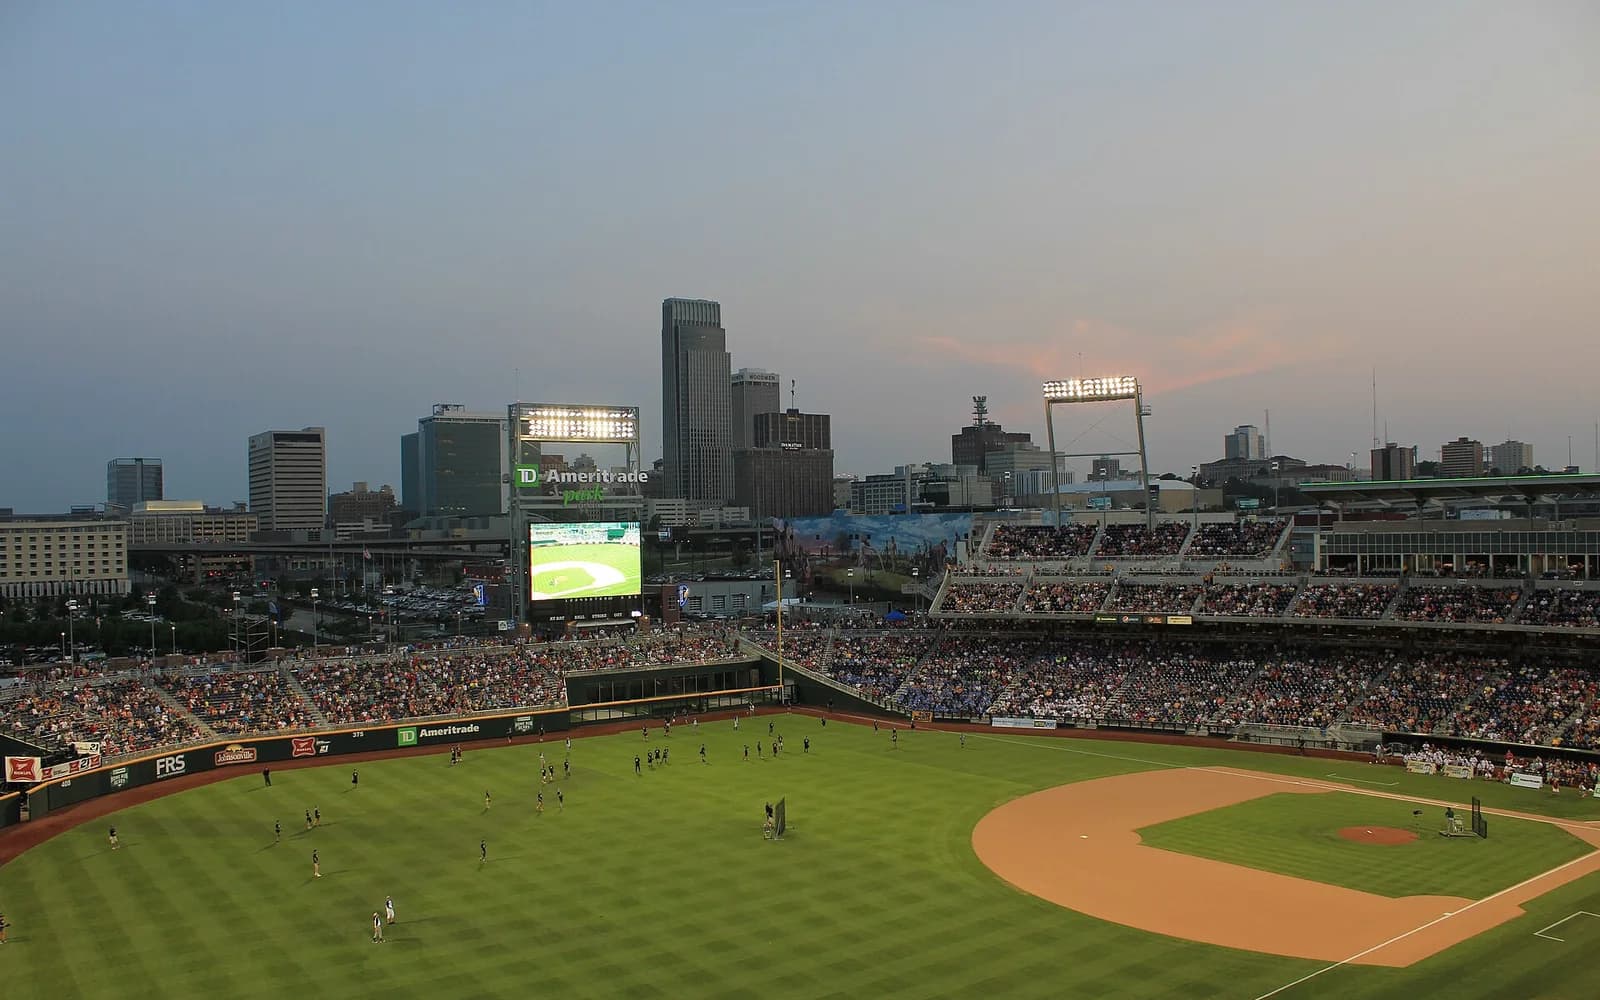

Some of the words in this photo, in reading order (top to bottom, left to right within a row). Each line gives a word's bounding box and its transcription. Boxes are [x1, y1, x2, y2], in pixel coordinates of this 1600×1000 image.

[517, 468, 536, 483] TD
[546, 468, 648, 483] Ameritrade
[564, 484, 604, 506] park
[399, 730, 415, 742] TD
[419, 723, 480, 737] Ameritrade
[156, 754, 186, 775] FRS
[217, 750, 254, 763] Johnsonville
